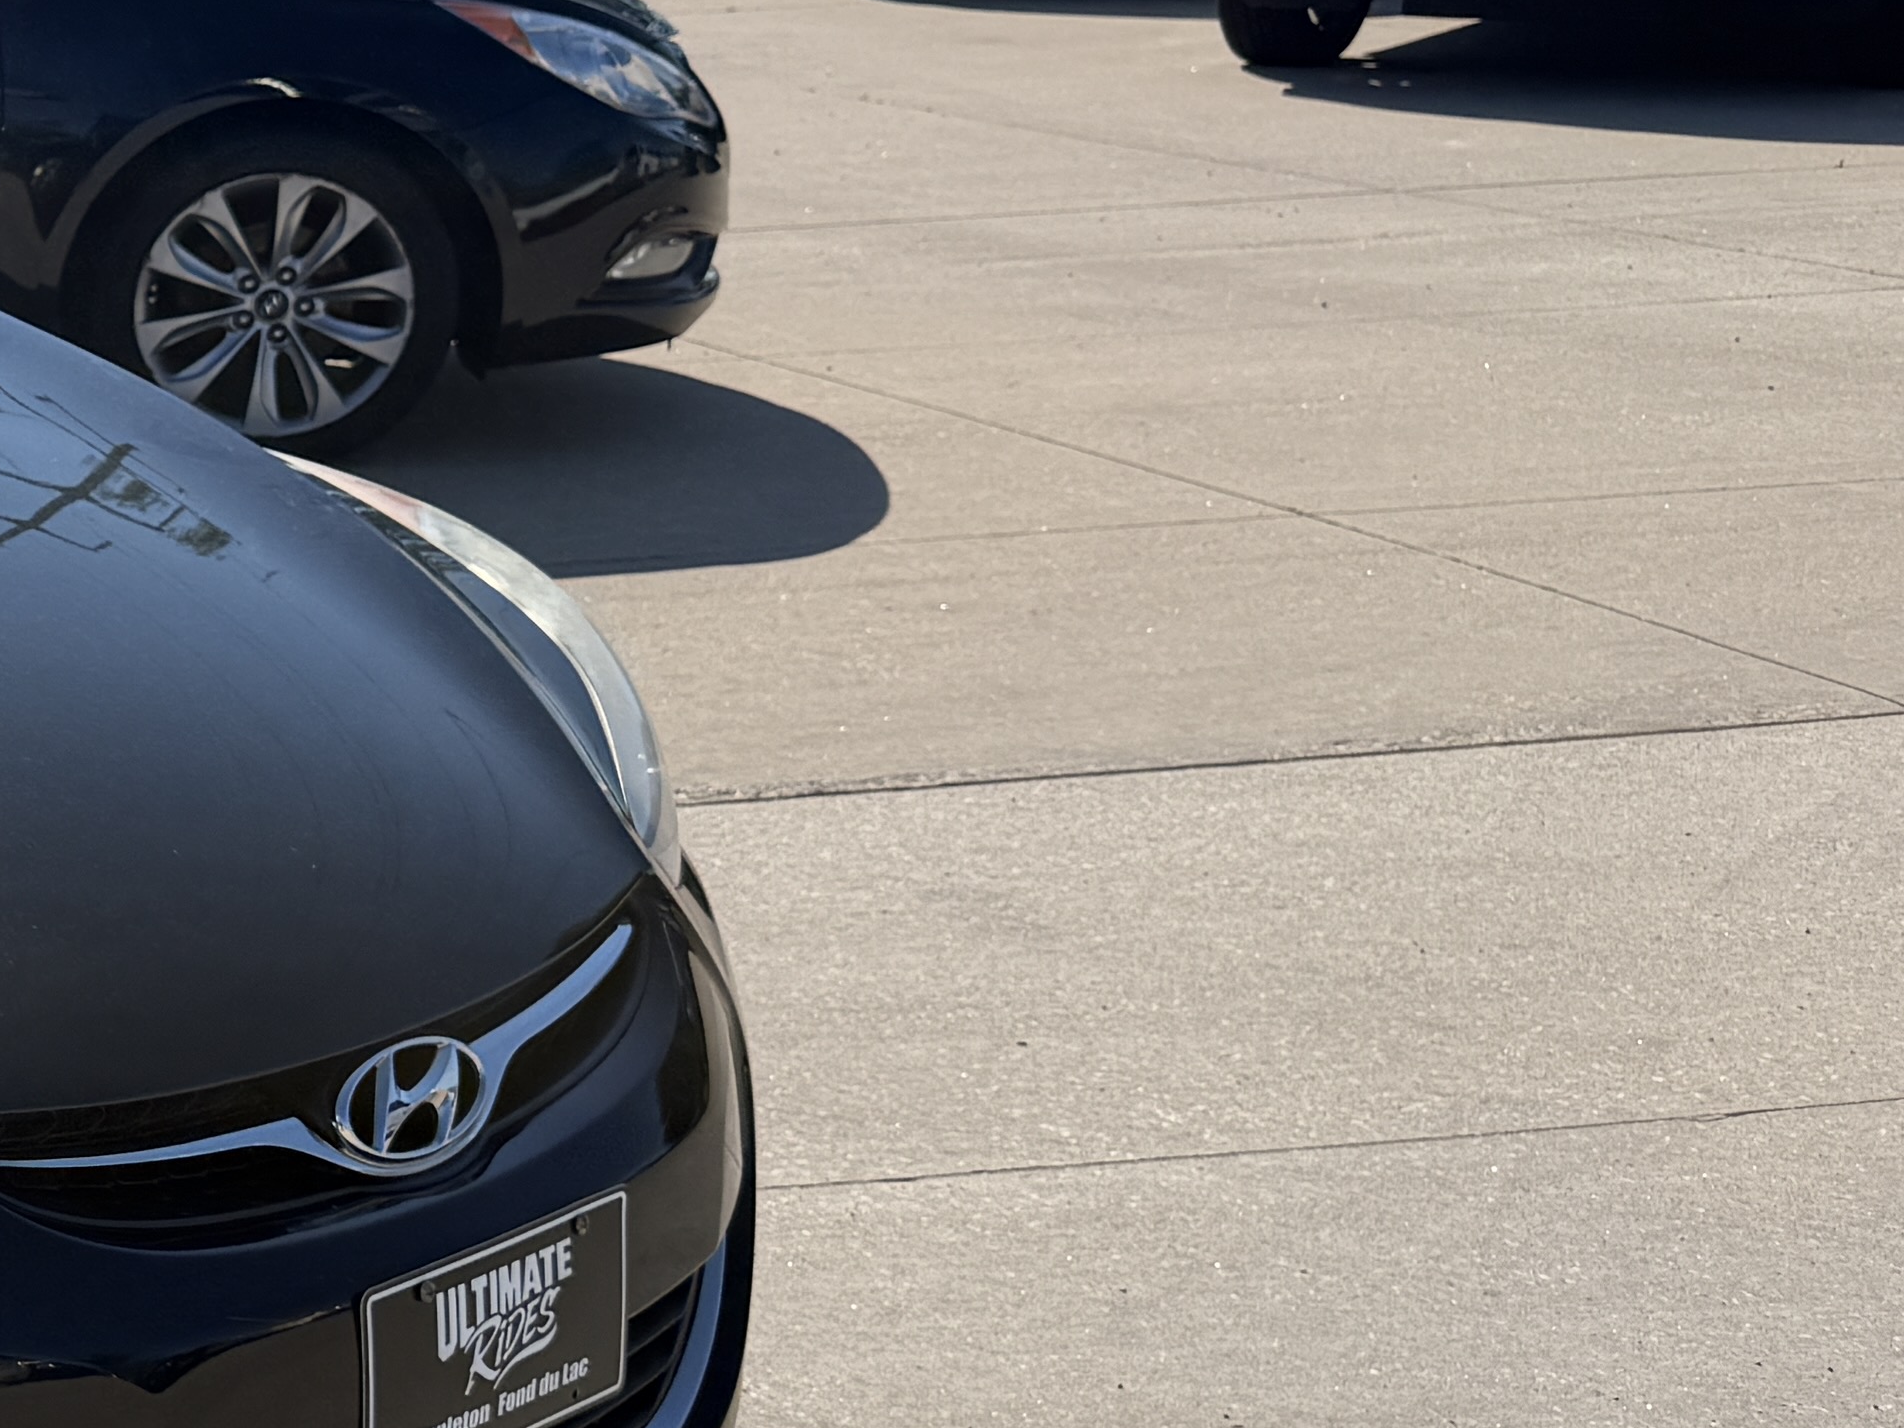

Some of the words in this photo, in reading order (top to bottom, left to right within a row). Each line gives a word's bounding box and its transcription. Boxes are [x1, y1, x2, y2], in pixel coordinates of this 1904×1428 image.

[435, 1236, 573, 1363] ULTIMATE
[496, 1377, 538, 1417] Fond
[538, 1370, 561, 1397] du
[562, 1357, 590, 1386] Lac
